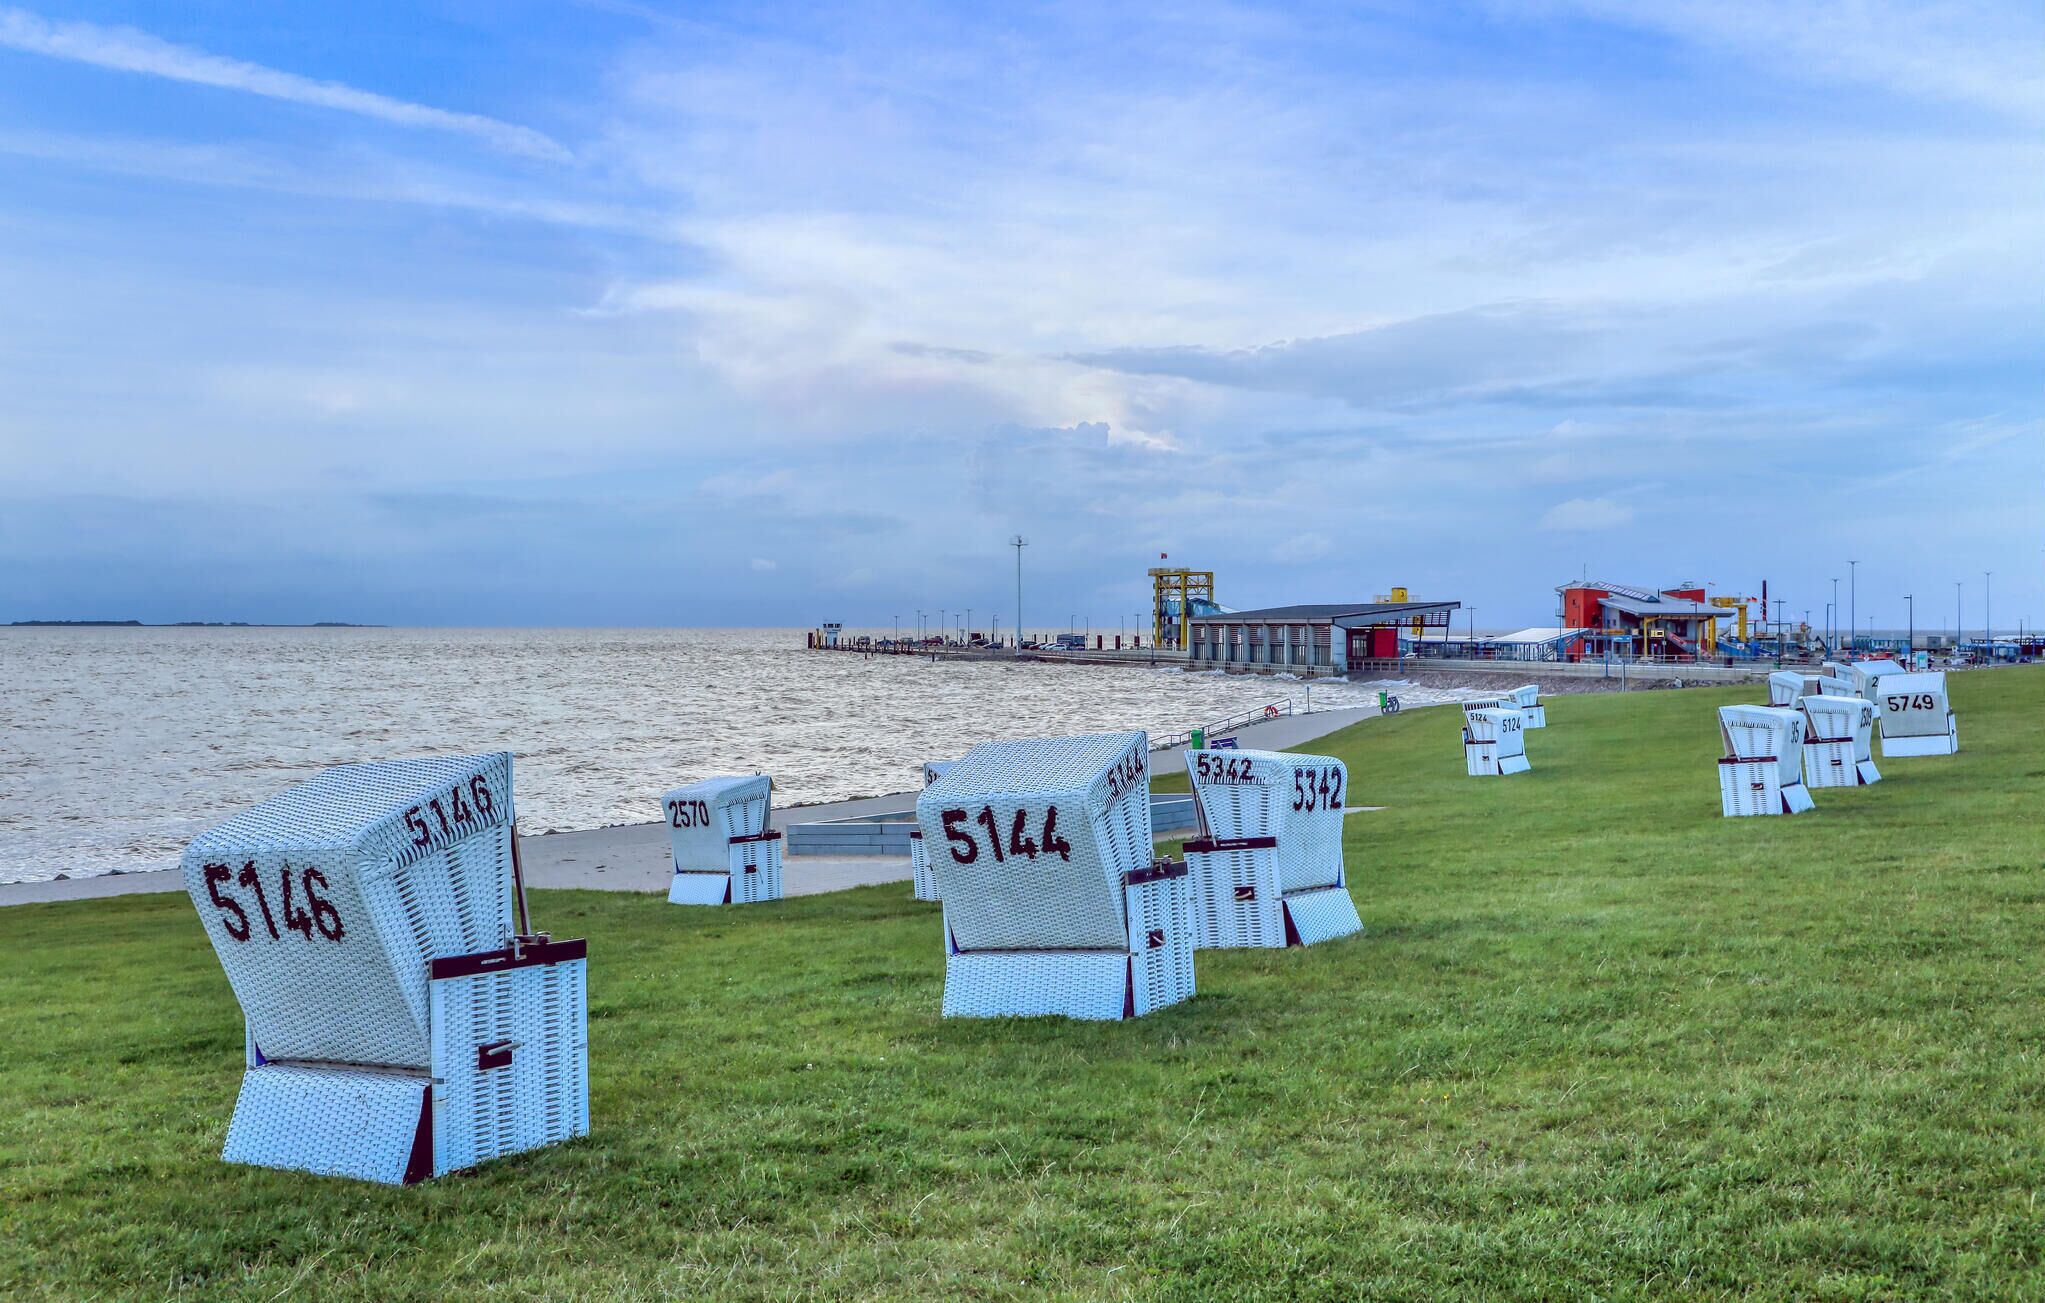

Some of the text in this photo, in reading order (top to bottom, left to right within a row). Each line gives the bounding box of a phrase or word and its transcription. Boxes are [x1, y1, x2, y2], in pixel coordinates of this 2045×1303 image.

[1470, 712, 1488, 722] 5124
[1887, 695, 1934, 712] 5749
[1502, 717, 1521, 733] 5124
[1107, 747, 1144, 798] 5144
[1197, 753, 1256, 783] 5342
[1292, 766, 1343, 812] 5342
[404, 774, 493, 846] 5146
[668, 799, 710, 829] 2570
[940, 805, 1072, 865] 5144
[203, 859, 346, 943] 5146
